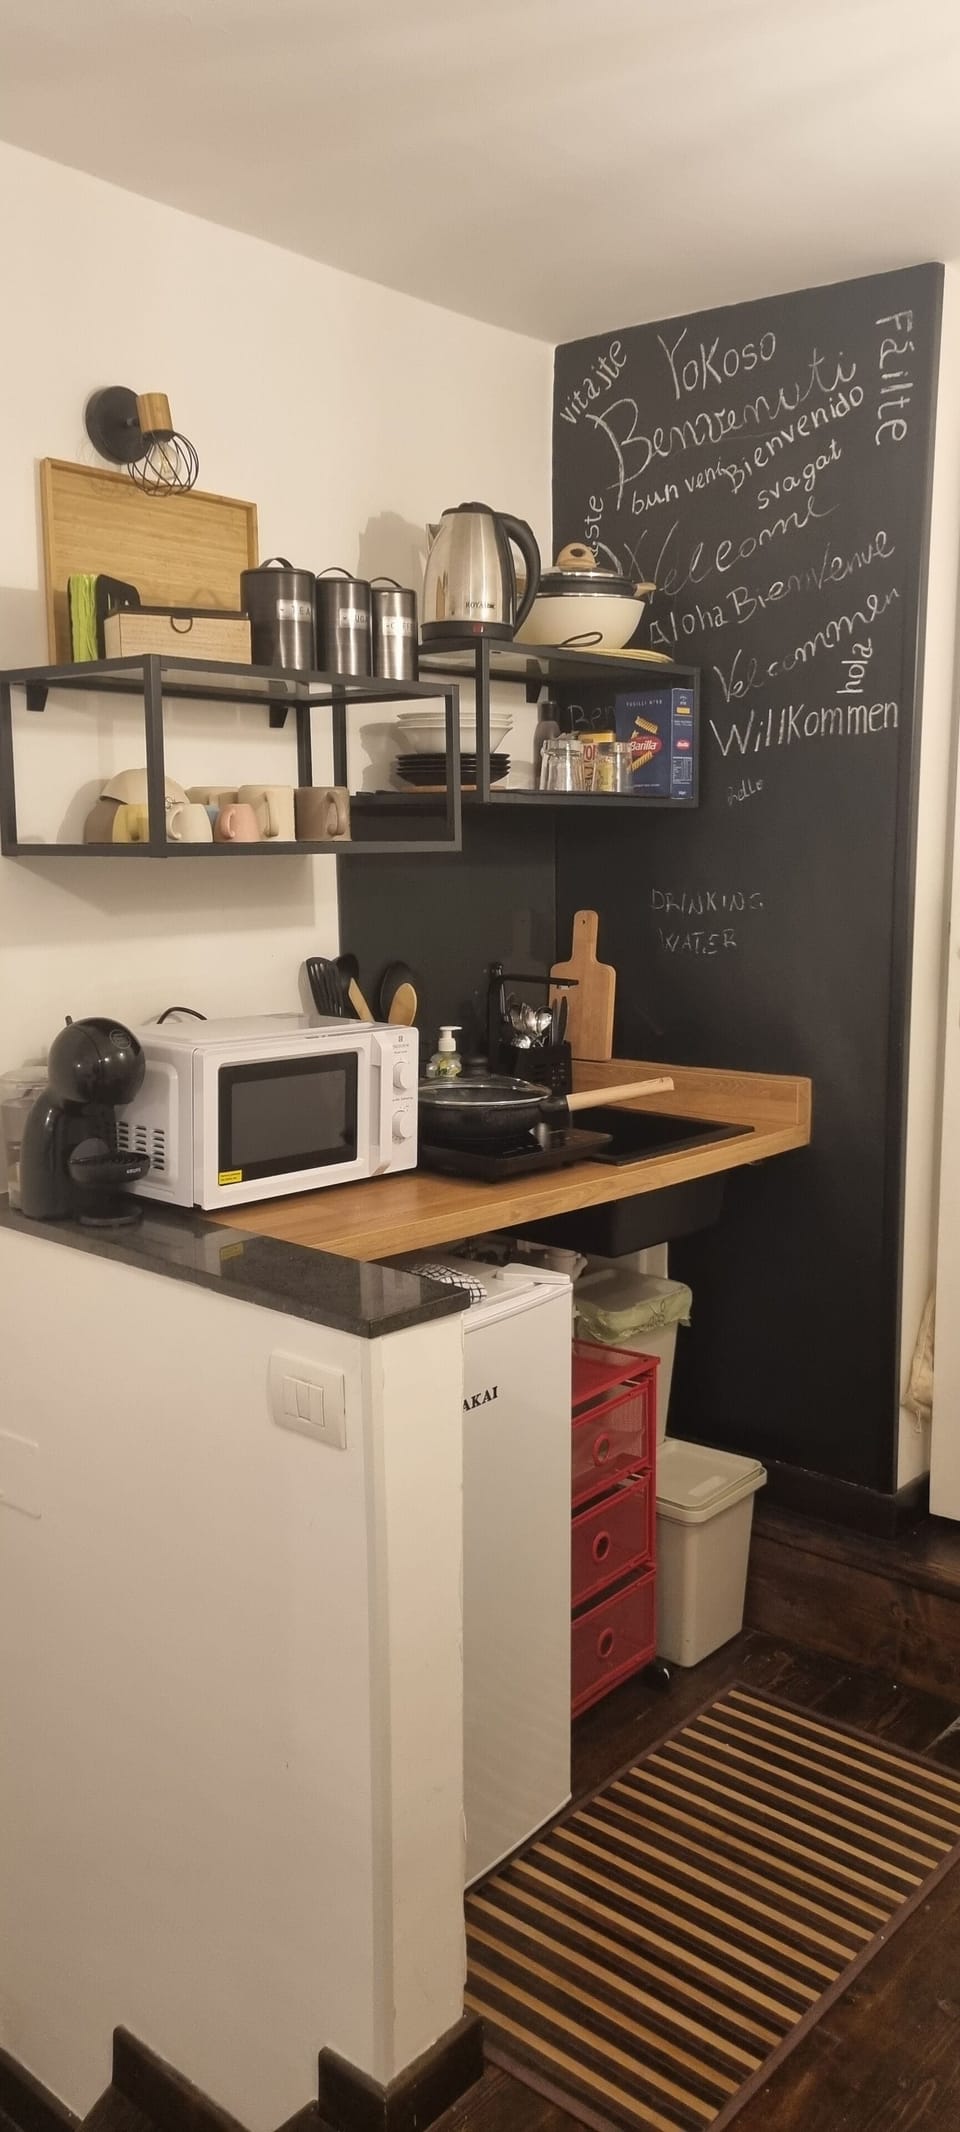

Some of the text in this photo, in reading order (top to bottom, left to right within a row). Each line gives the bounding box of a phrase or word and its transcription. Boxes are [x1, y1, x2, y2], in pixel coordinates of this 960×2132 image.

[585, 347, 857, 510] Benvenuti
[720, 385, 864, 494] Bienvenido
[757, 438, 843, 510] svagat
[631, 482, 679, 515] bun
[649, 603, 728, 647] Aloha
[836, 638, 873, 694] hola
[631, 739, 657, 751] Barilla
[650, 888, 764, 915] DRINKING
[658, 927, 738, 955] WATER
[462, 1385, 498, 1412] AKAI
